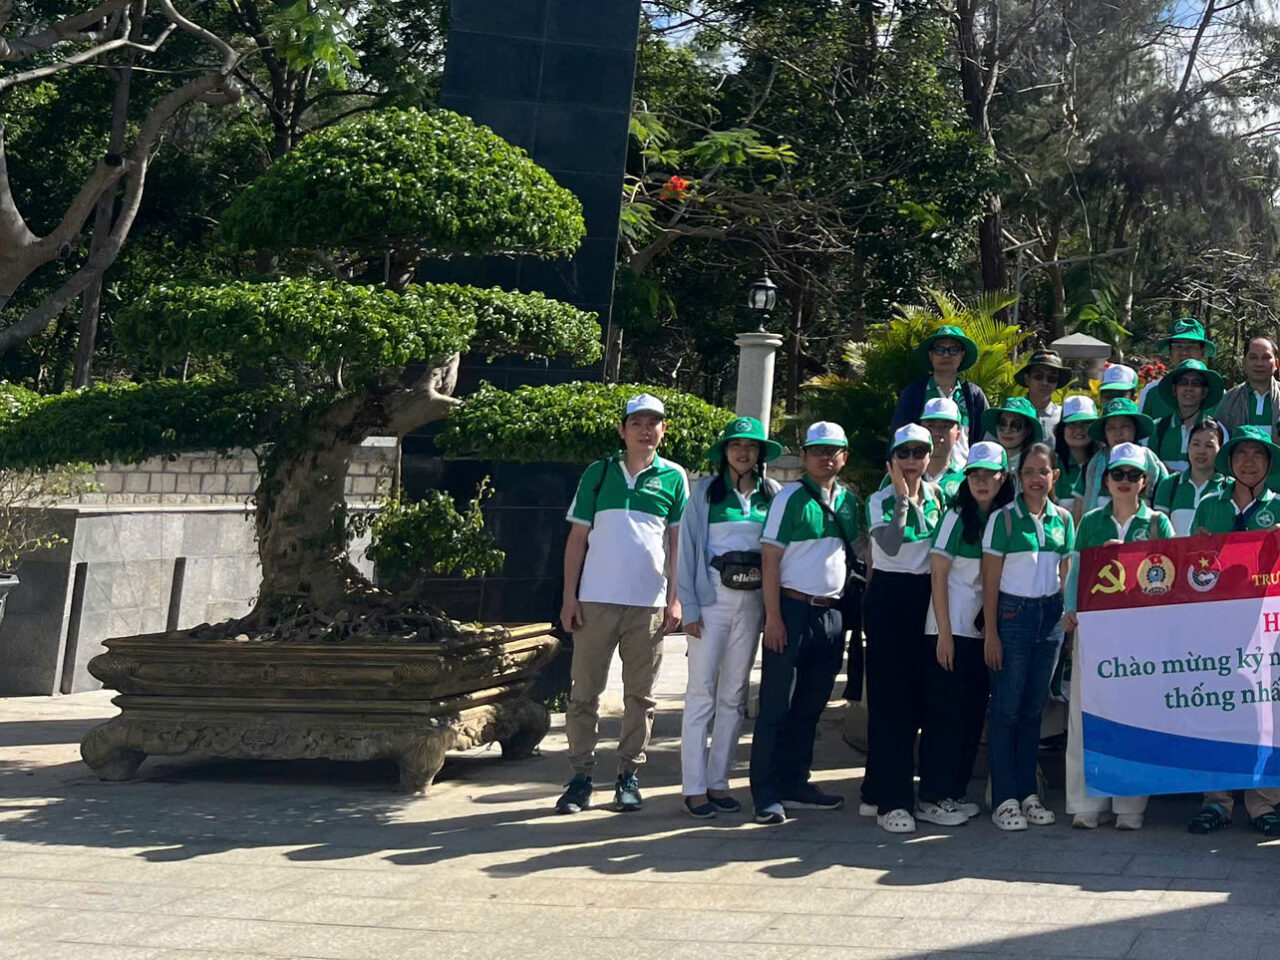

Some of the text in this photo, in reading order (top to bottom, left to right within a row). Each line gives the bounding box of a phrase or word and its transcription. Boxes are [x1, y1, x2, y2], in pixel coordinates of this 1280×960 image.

[1097, 656, 1156, 678] Chào
[1161, 651, 1232, 676] mừng
[1236, 646, 1264, 674] kỷ
[1164, 682, 1236, 712] thống
